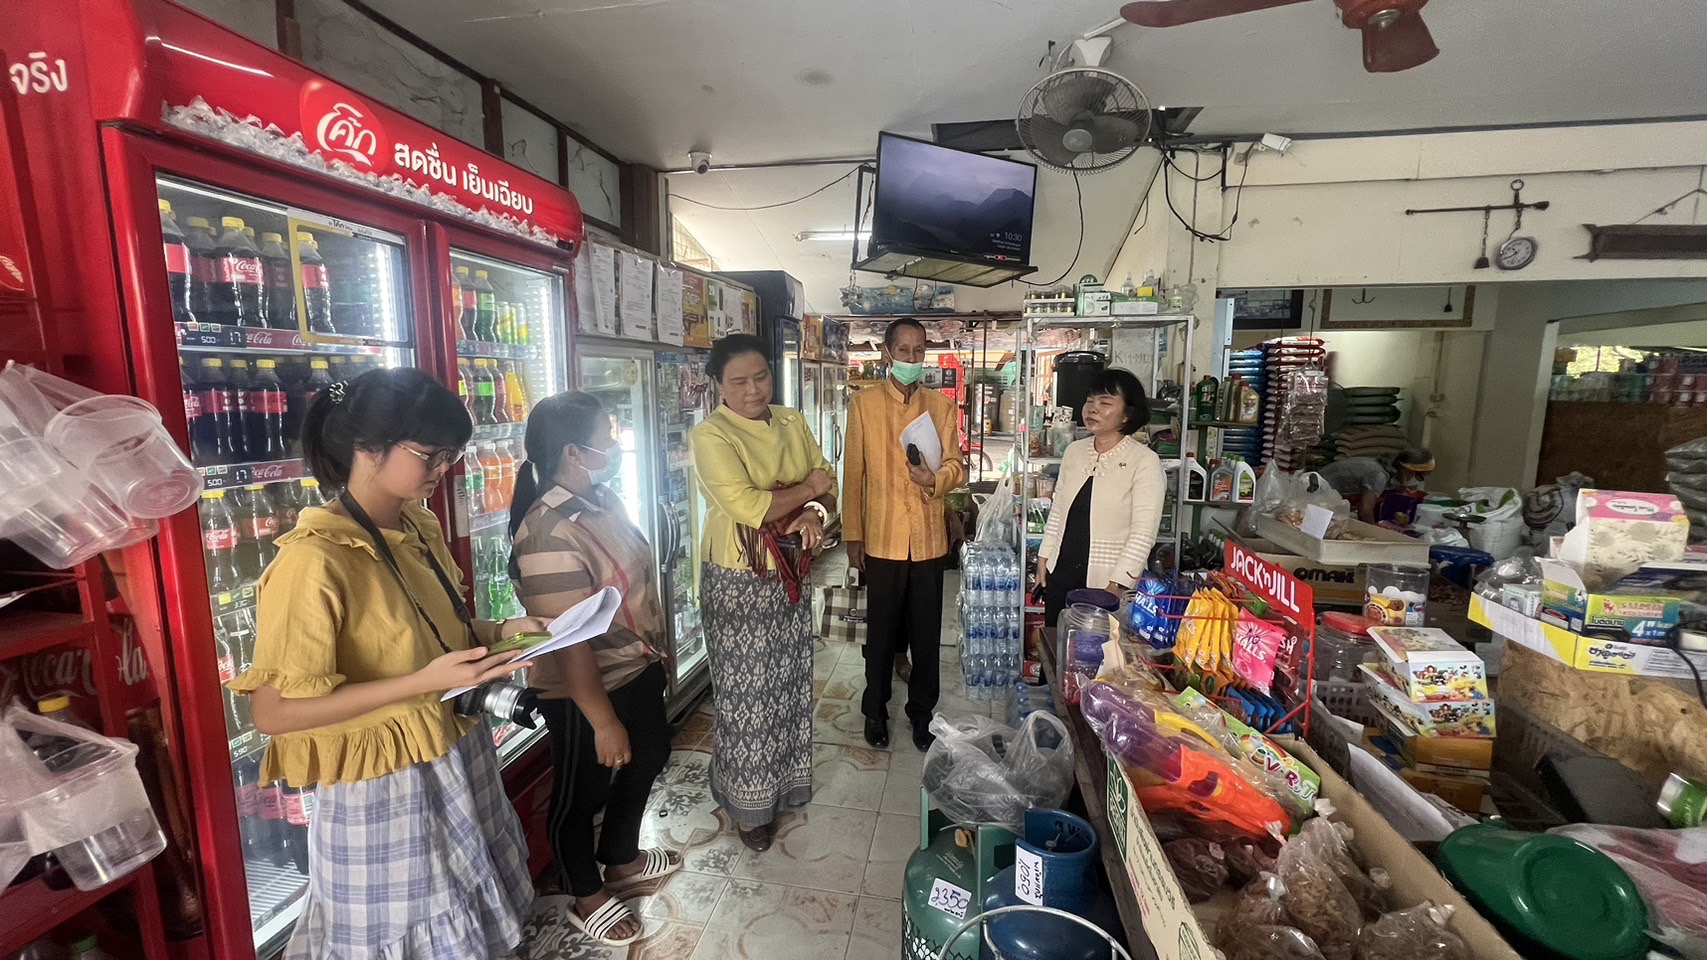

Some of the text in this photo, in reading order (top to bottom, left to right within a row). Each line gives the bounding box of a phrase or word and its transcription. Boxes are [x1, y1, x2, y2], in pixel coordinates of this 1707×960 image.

[9, 51, 68, 95] จริง
[394, 142, 534, 215] สดชื่น เย็นเฉียบ
[1004, 231, 1022, 242] 10:30
[201, 336, 216, 344] 500
[229, 331, 242, 343] 17
[235, 469, 247, 480] 17
[207, 477, 223, 487] 500
[1270, 570, 1300, 614] JILL
[1632, 620, 1646, 637] 4
